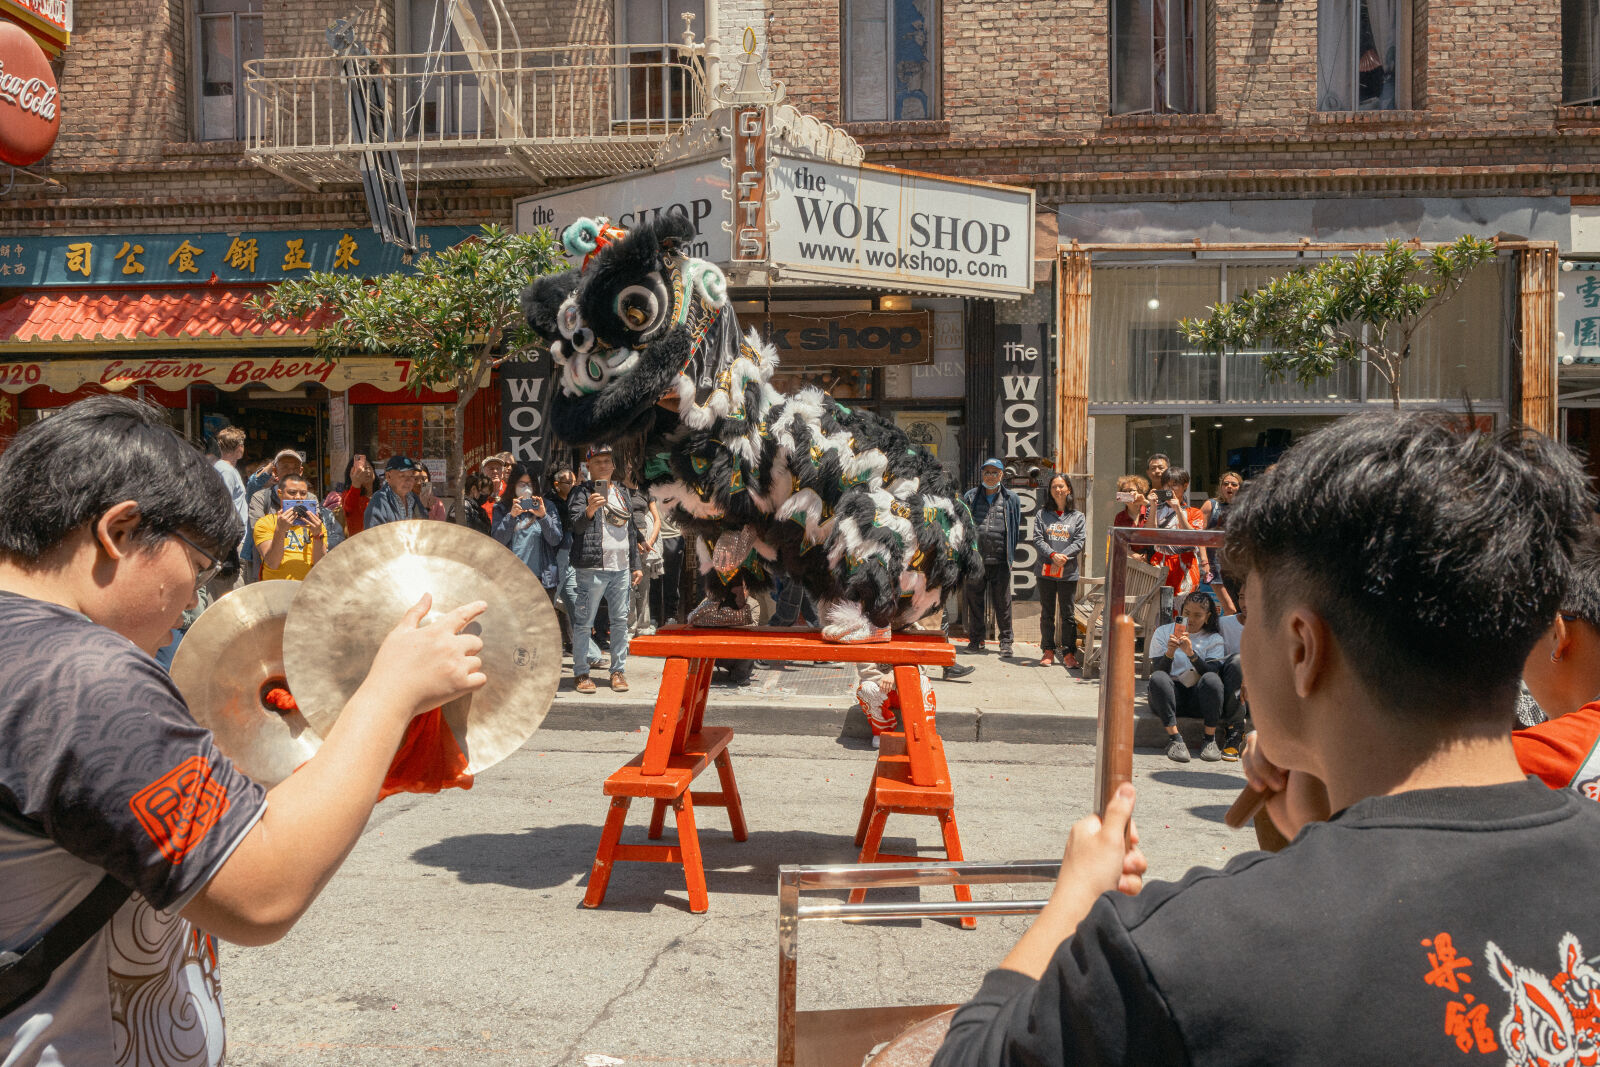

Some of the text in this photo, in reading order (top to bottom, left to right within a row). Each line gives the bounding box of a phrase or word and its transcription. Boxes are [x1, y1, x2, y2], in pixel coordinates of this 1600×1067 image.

[738, 111, 763, 257] GIFTS
[794, 166, 826, 193] the
[532, 205, 555, 227] the
[794, 195, 1011, 258] WOK SHOP
[800, 320, 922, 355] shop
[1003, 341, 1038, 362] the
[100, 359, 336, 385] Eastern Bakery
[506, 378, 544, 462] WOK
[1001, 375, 1042, 458] WOK
